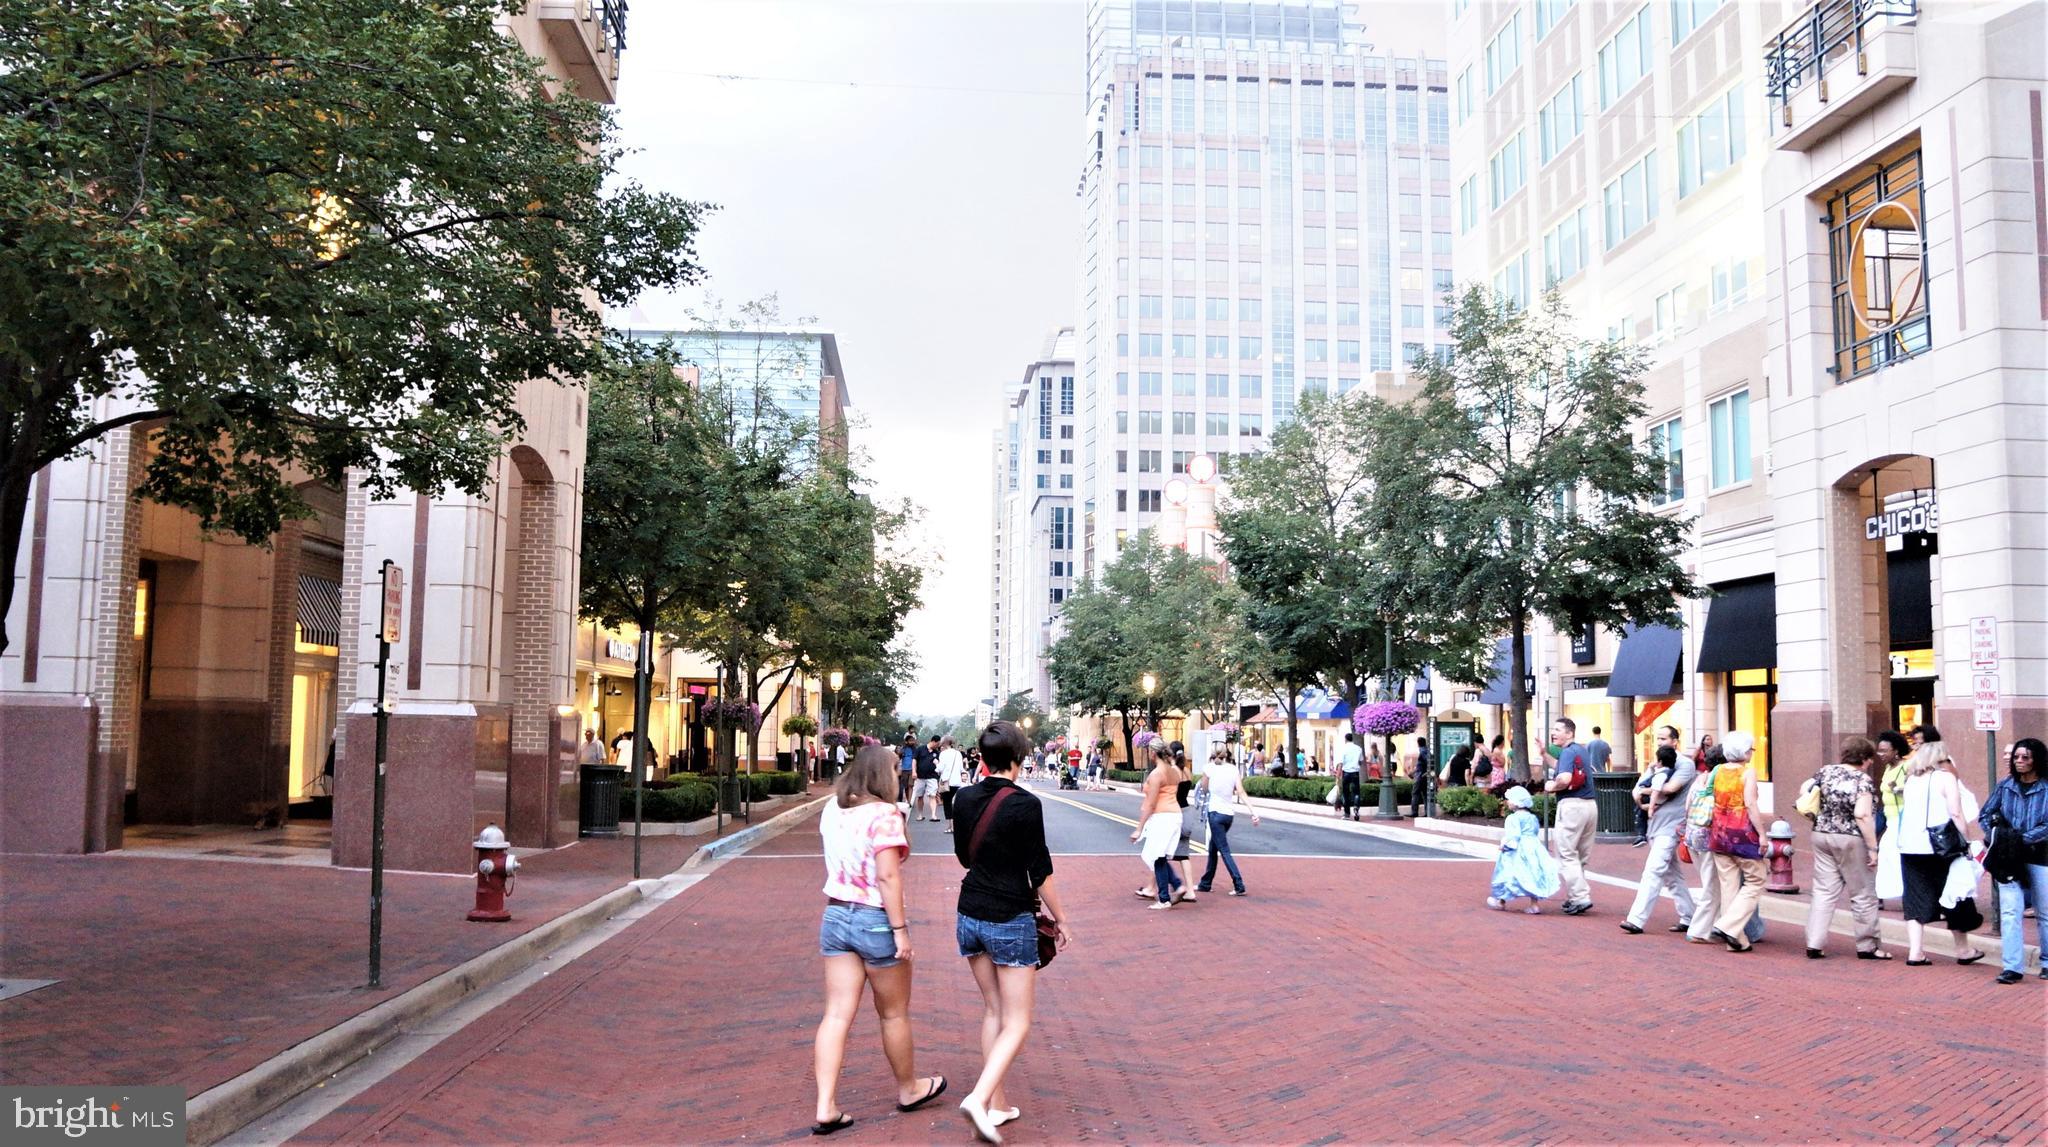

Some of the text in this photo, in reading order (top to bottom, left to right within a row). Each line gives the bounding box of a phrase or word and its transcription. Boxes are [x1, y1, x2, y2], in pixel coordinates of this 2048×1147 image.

[1865, 501, 1938, 540] CHICO'S
[1980, 679, 1991, 689] NO
[1417, 692, 1432, 704] GAP
[1975, 691, 1997, 701] PARKING
